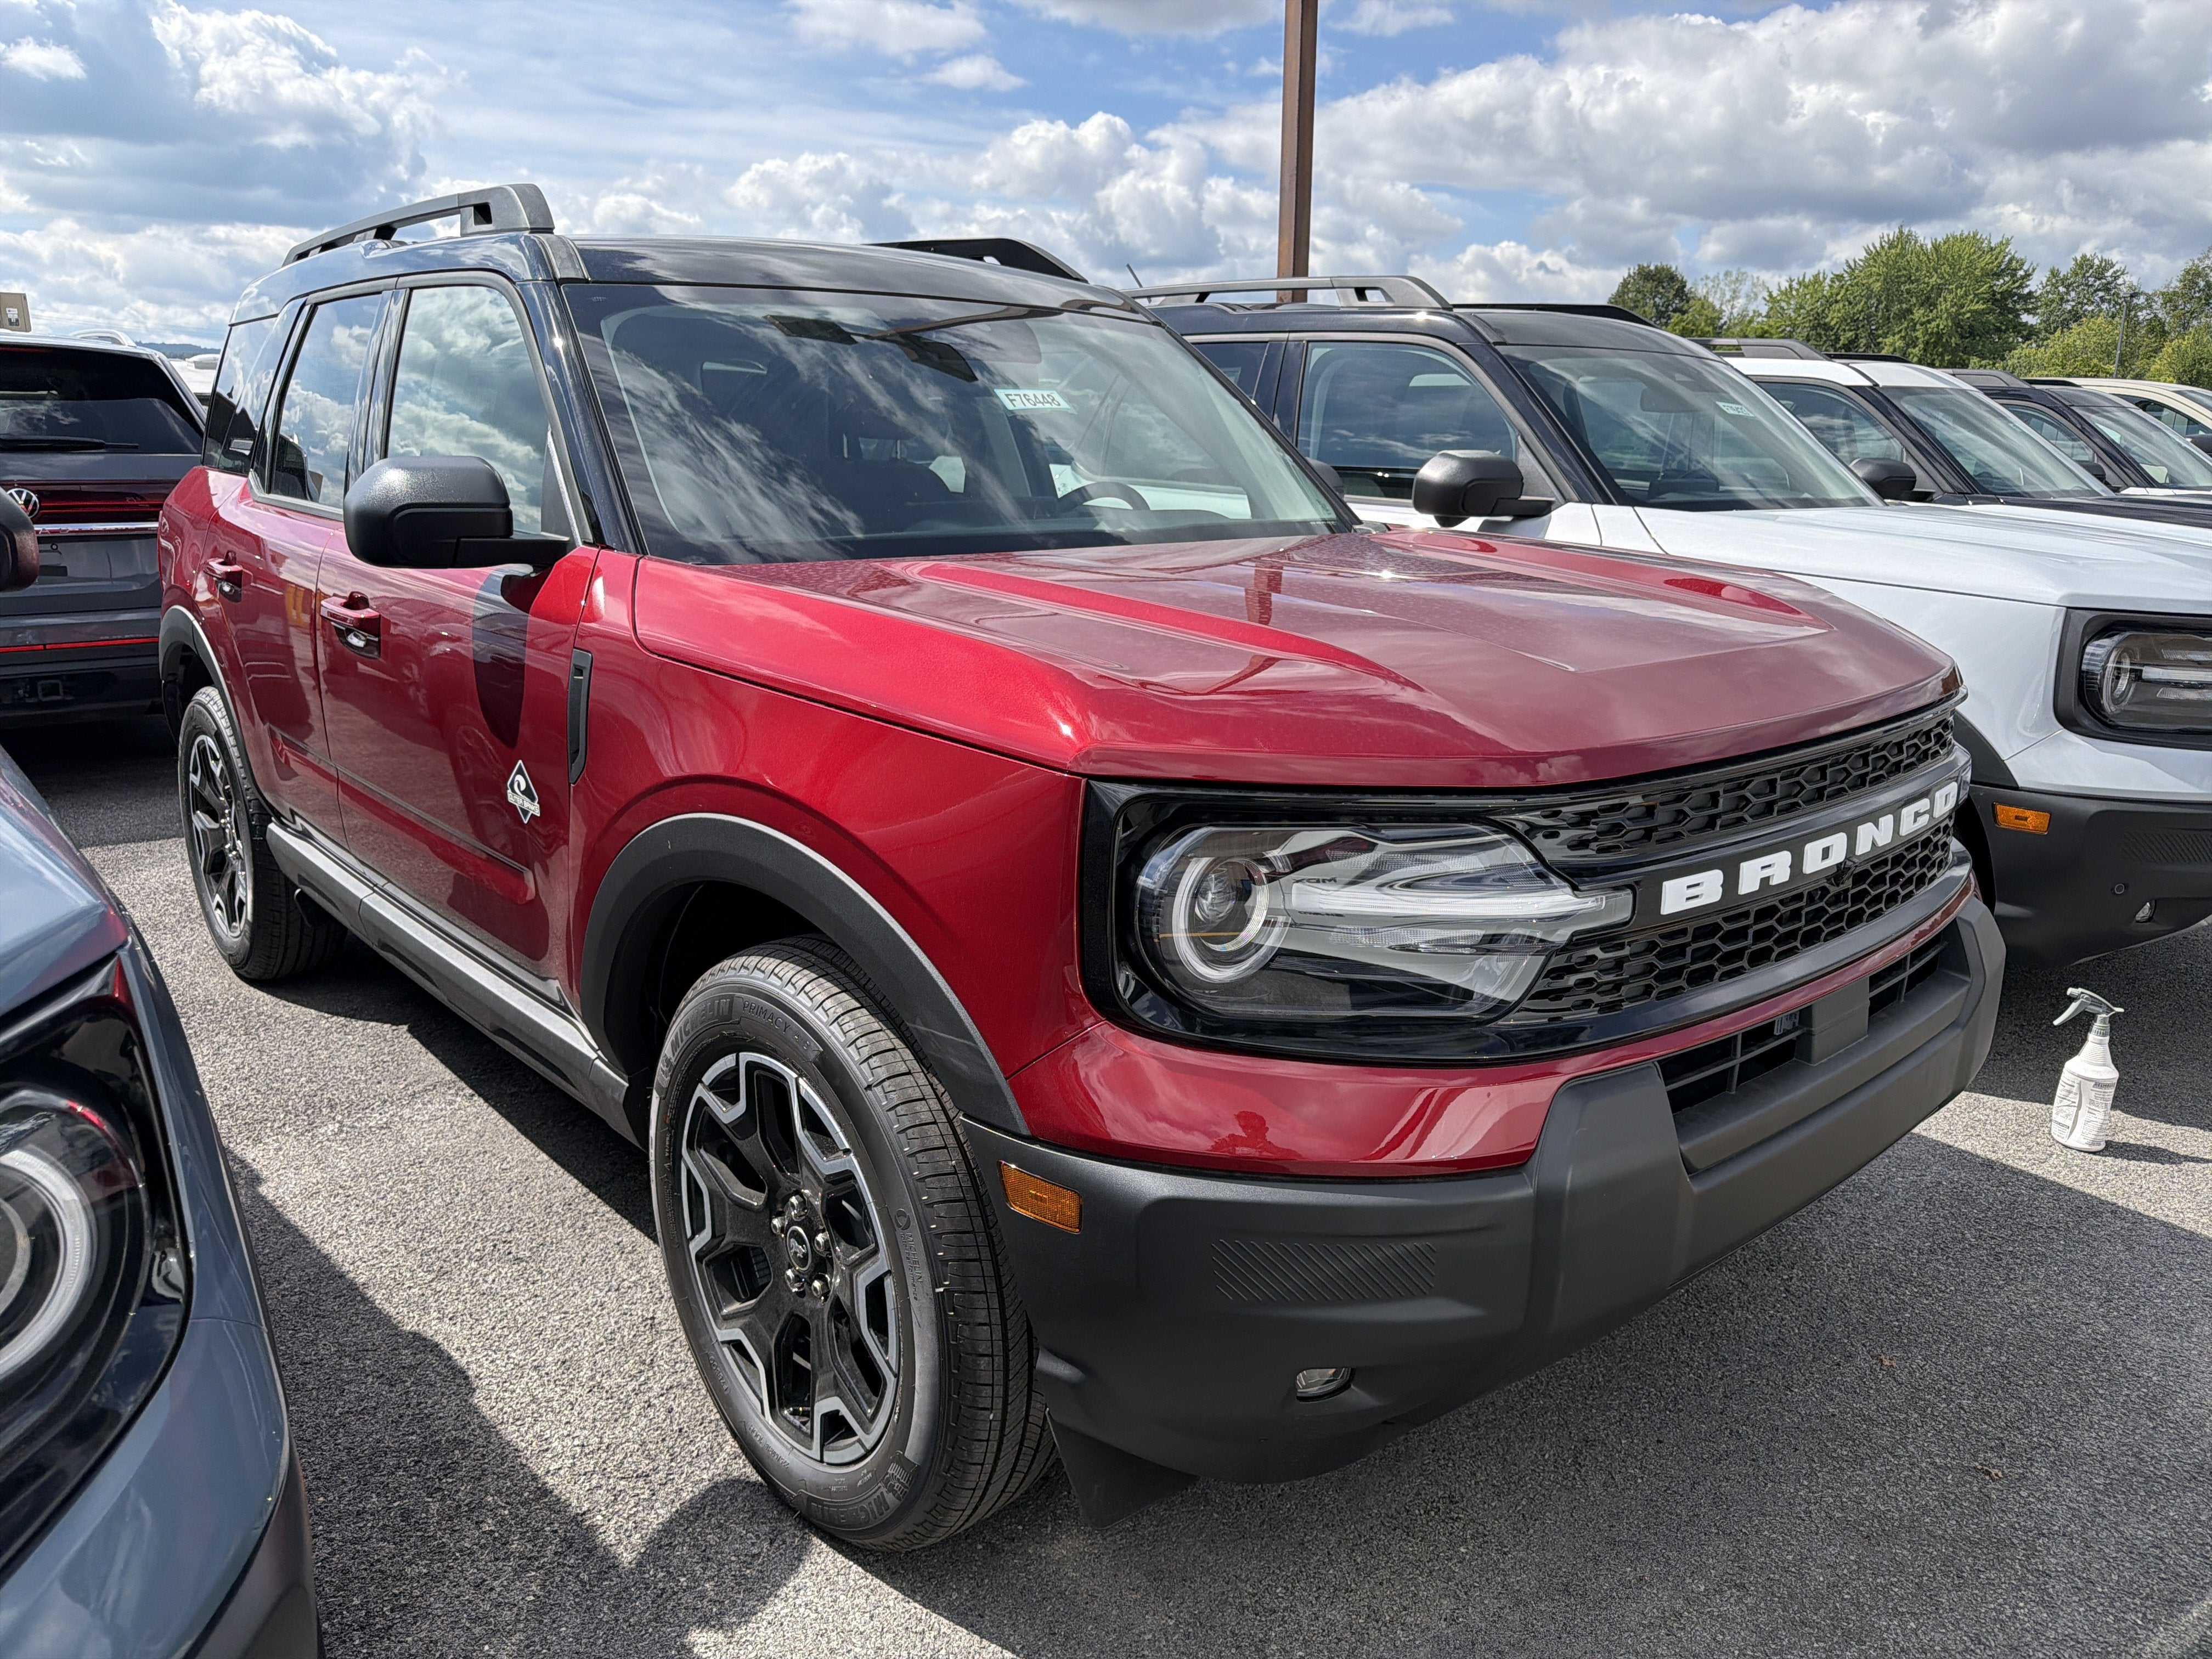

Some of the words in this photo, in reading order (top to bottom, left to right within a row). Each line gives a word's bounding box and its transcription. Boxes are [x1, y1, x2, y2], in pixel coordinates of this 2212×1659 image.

[1005, 393, 1061, 408] F76448
[509, 794, 523, 805] OUTER
[523, 801, 539, 813] BANKS
[1660, 781, 1958, 915] BRONCO
[670, 999, 730, 1057] MICHELIN
[743, 1001, 791, 1034] PRIMACY
[906, 1232, 923, 1282] MICHELIN
[810, 1491, 890, 1526] MICHELIN
